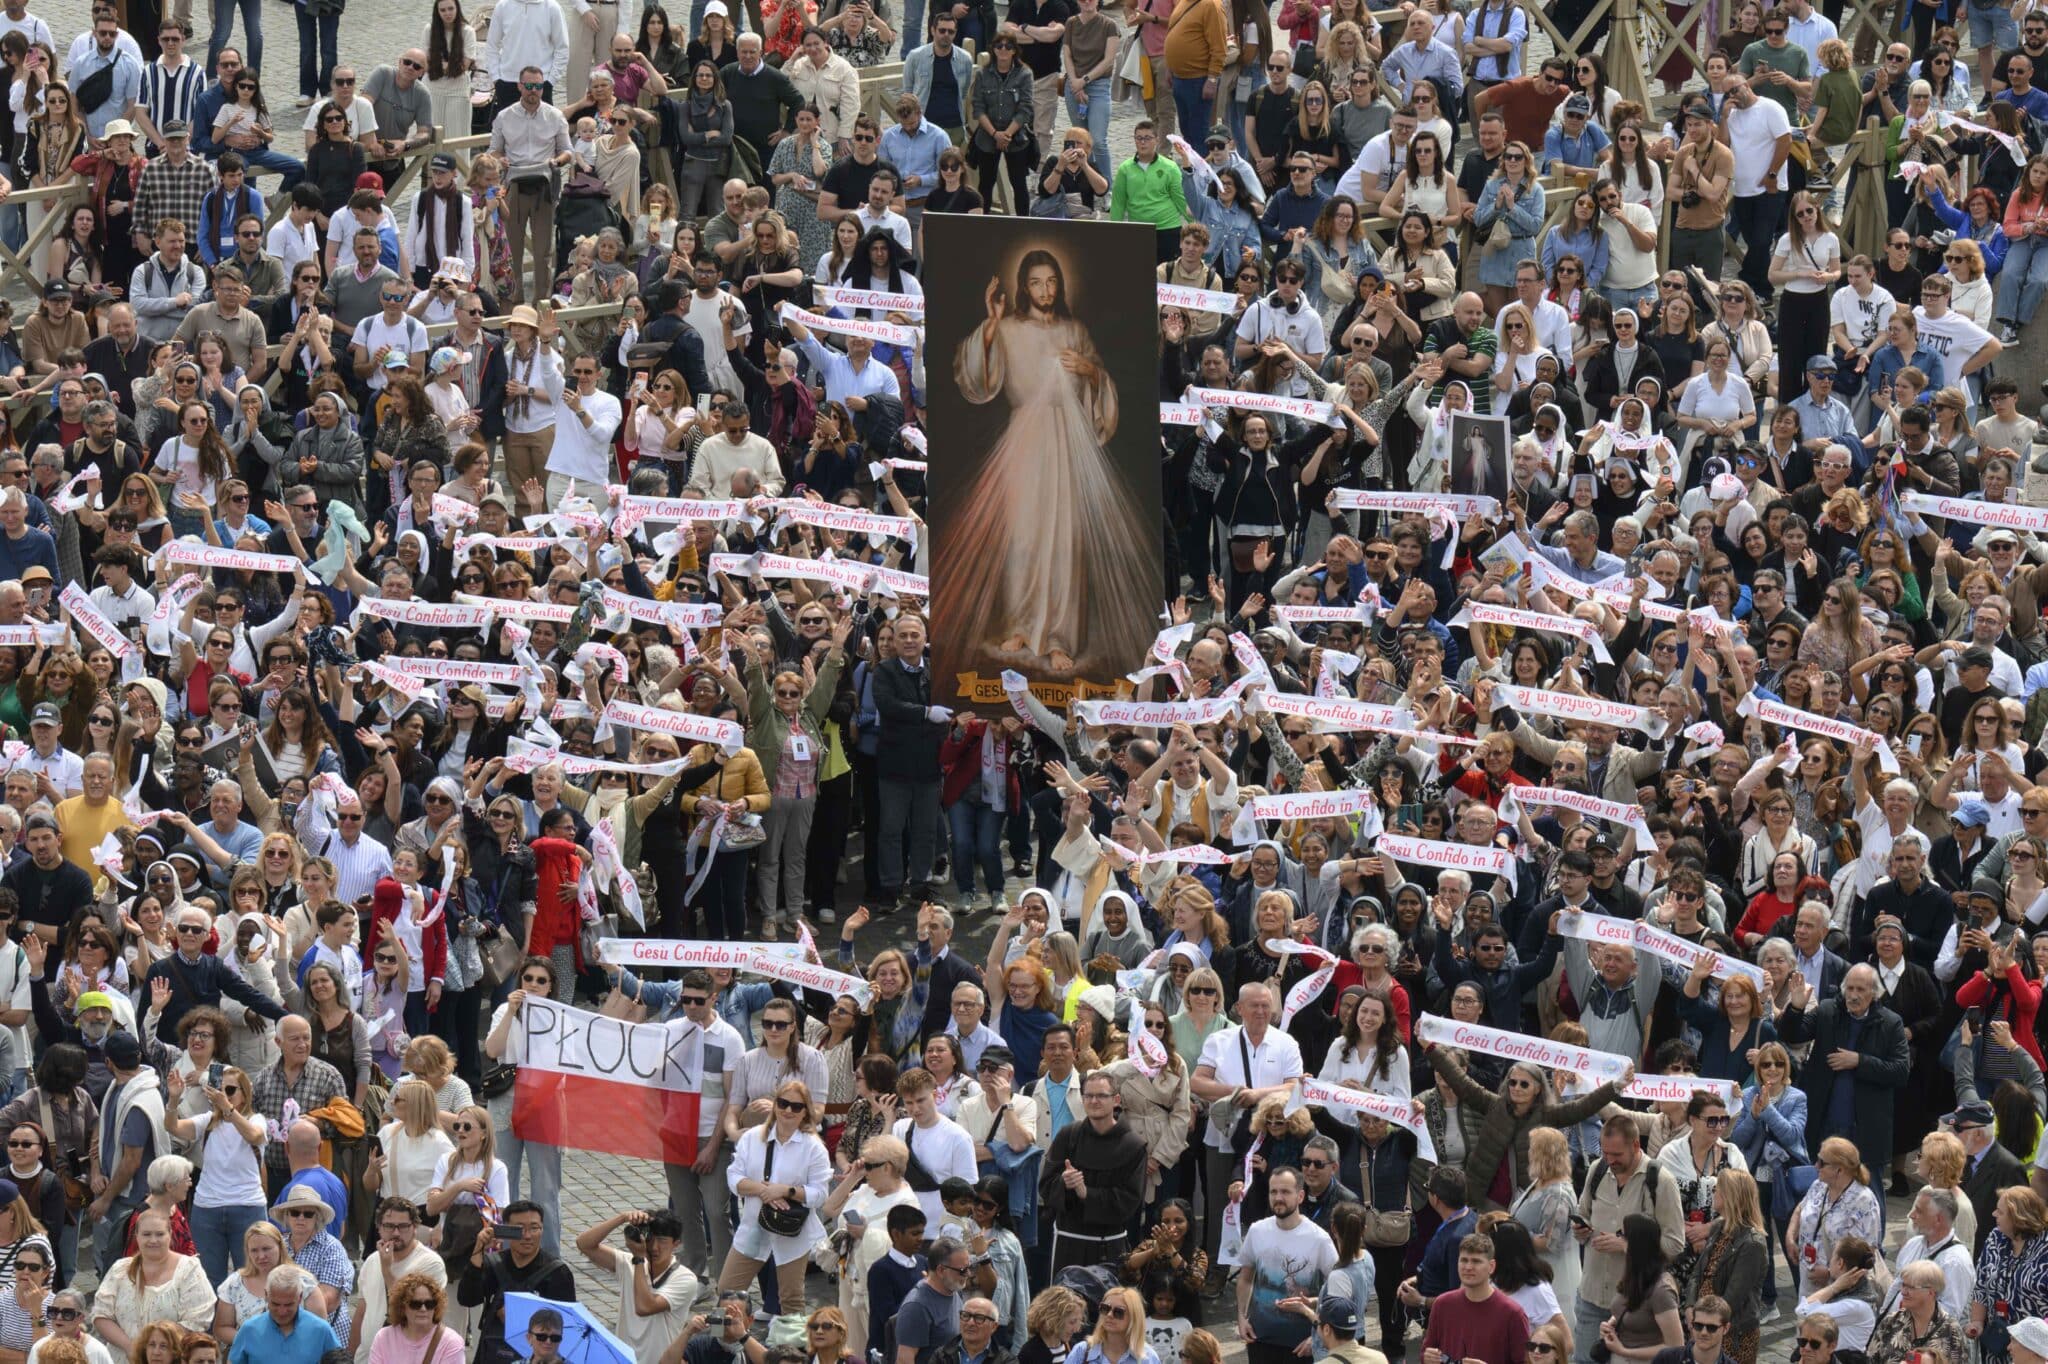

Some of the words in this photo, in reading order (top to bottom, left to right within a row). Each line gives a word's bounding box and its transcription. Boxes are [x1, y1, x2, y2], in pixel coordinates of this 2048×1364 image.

[868, 293, 914, 309] Confido
[1157, 287, 1177, 303] fido
[1180, 291, 1190, 304] in
[1196, 292, 1207, 306] Te
[878, 326, 888, 337] in
[892, 327, 902, 340] Te
[1170, 408, 1182, 421] in
[1187, 408, 1200, 422] Te
[1286, 400, 1298, 411] in
[1303, 402, 1316, 415] Te
[655, 501, 704, 517] Confido
[707, 503, 720, 517] in
[726, 503, 738, 516] Te
[1466, 499, 1478, 513] Te
[823, 512, 874, 530] Confido
[878, 518, 891, 532] in
[896, 520, 910, 535] Te
[1974, 505, 2022, 526] Confido
[2025, 513, 2037, 528] in
[203, 550, 254, 568] Confido
[258, 555, 271, 570] in
[847, 569, 858, 582] in
[405, 605, 452, 624] Confido
[456, 608, 467, 623] in
[520, 604, 572, 618] Confido
[682, 609, 695, 624] in
[701, 608, 714, 624] Te
[69, 596, 105, 637] Confido
[103, 631, 117, 648] in
[10, 630, 22, 643] in
[436, 661, 487, 680] Confido
[491, 663, 504, 679] in
[509, 666, 520, 681] Te
[1518, 690, 1531, 707] Te
[1536, 691, 1549, 708] in
[1553, 695, 1602, 717] Confido
[552, 703, 565, 719] Te
[1133, 706, 1182, 724] Confido
[1185, 708, 1197, 720] in
[1202, 703, 1213, 718] Te
[1304, 701, 1358, 721] Confido
[1361, 709, 1375, 724] in
[1380, 710, 1394, 726] Te
[640, 710, 693, 734] Confido
[696, 720, 709, 737] in
[714, 722, 729, 740] Te
[1793, 712, 1845, 736] Confido
[1284, 799, 1336, 818] Confido
[1340, 797, 1353, 814] in
[1358, 793, 1370, 809] Te
[1552, 788, 1602, 813] Confido
[1605, 804, 1619, 818] in
[1624, 806, 1637, 823] Te
[1416, 843, 1469, 866] Confido
[1473, 851, 1486, 867] in
[1493, 851, 1505, 869] Te
[633, 941, 669, 960] Gesù
[674, 944, 730, 963] Confido
[734, 947, 748, 963] in
[1635, 925, 1688, 959] Confido
[779, 961, 821, 986] Confido
[823, 970, 835, 989] in
[838, 977, 850, 992] Te
[526, 1003, 697, 1085] PŁOCK
[1454, 1027, 1490, 1049] Gesù
[1494, 1036, 1551, 1062] Confido
[1554, 1049, 1569, 1067] in
[1574, 1052, 1590, 1071] Te
[1632, 1078, 1686, 1098] Confido
[1333, 1090, 1389, 1113] Confido
[1392, 1103, 1408, 1120] in
